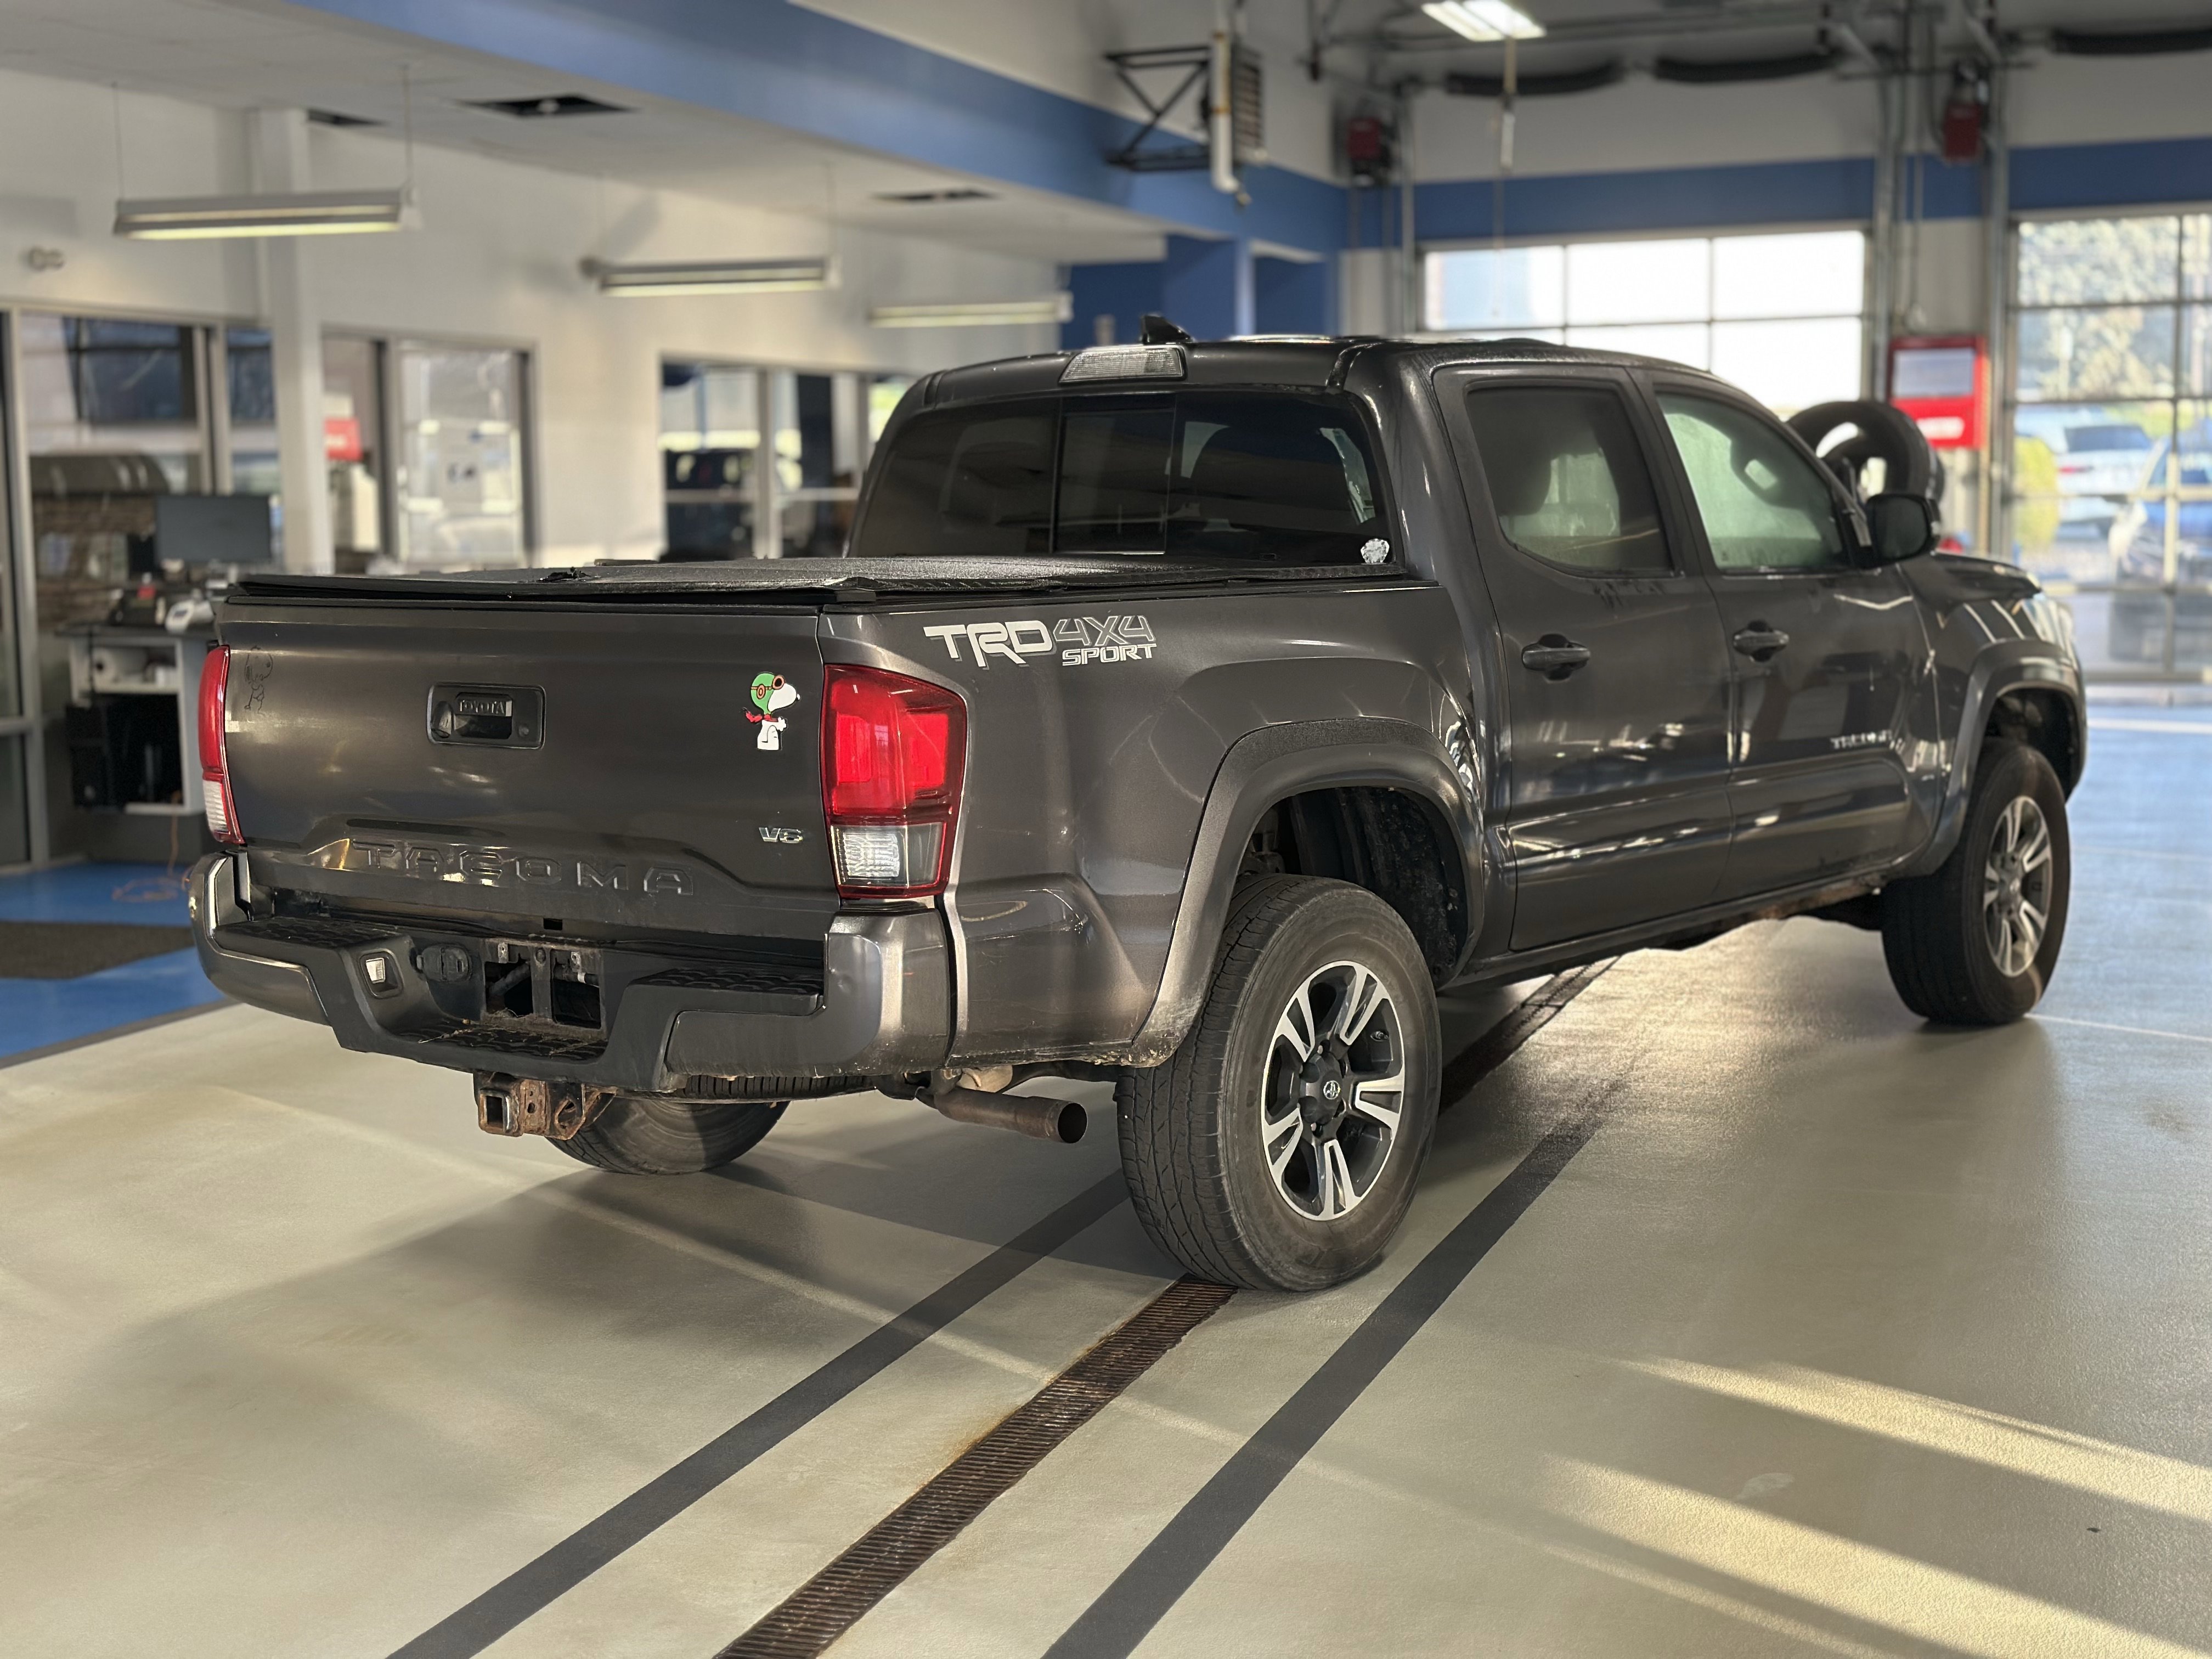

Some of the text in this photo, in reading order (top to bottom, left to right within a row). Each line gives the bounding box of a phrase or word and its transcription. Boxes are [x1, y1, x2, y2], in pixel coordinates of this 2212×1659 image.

[923, 620, 1057, 670] TRD
[1062, 644, 1157, 666] SPORT
[759, 827, 803, 844] V6
[352, 838, 693, 895] TACOMA
